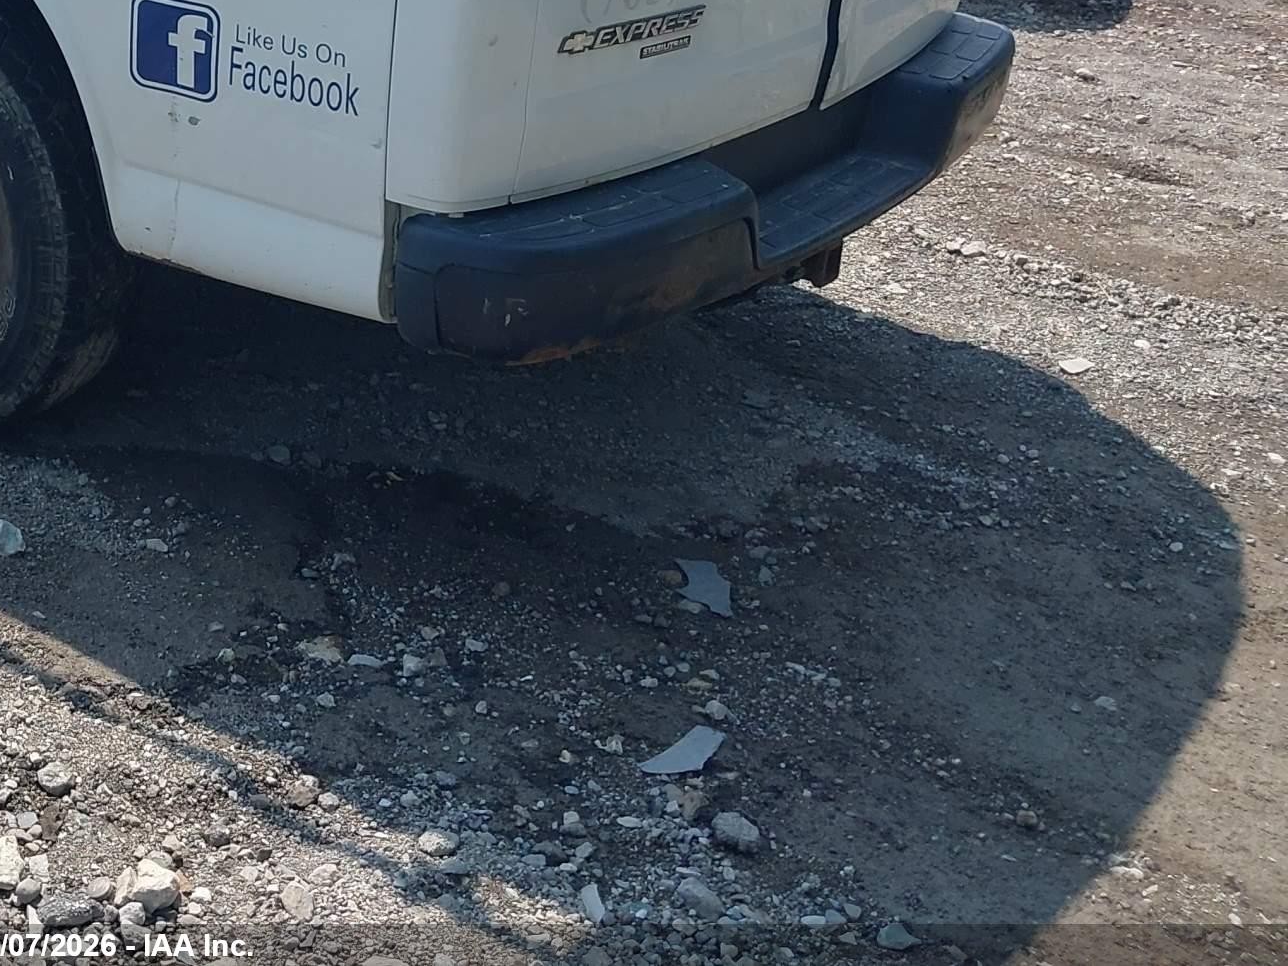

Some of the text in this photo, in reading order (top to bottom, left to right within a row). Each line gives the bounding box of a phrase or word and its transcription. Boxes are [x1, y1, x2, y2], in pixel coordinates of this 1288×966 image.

[235, 23, 346, 68] Like Us On
[594, 8, 705, 48] EXPRESS
[228, 45, 360, 117] Facebook
